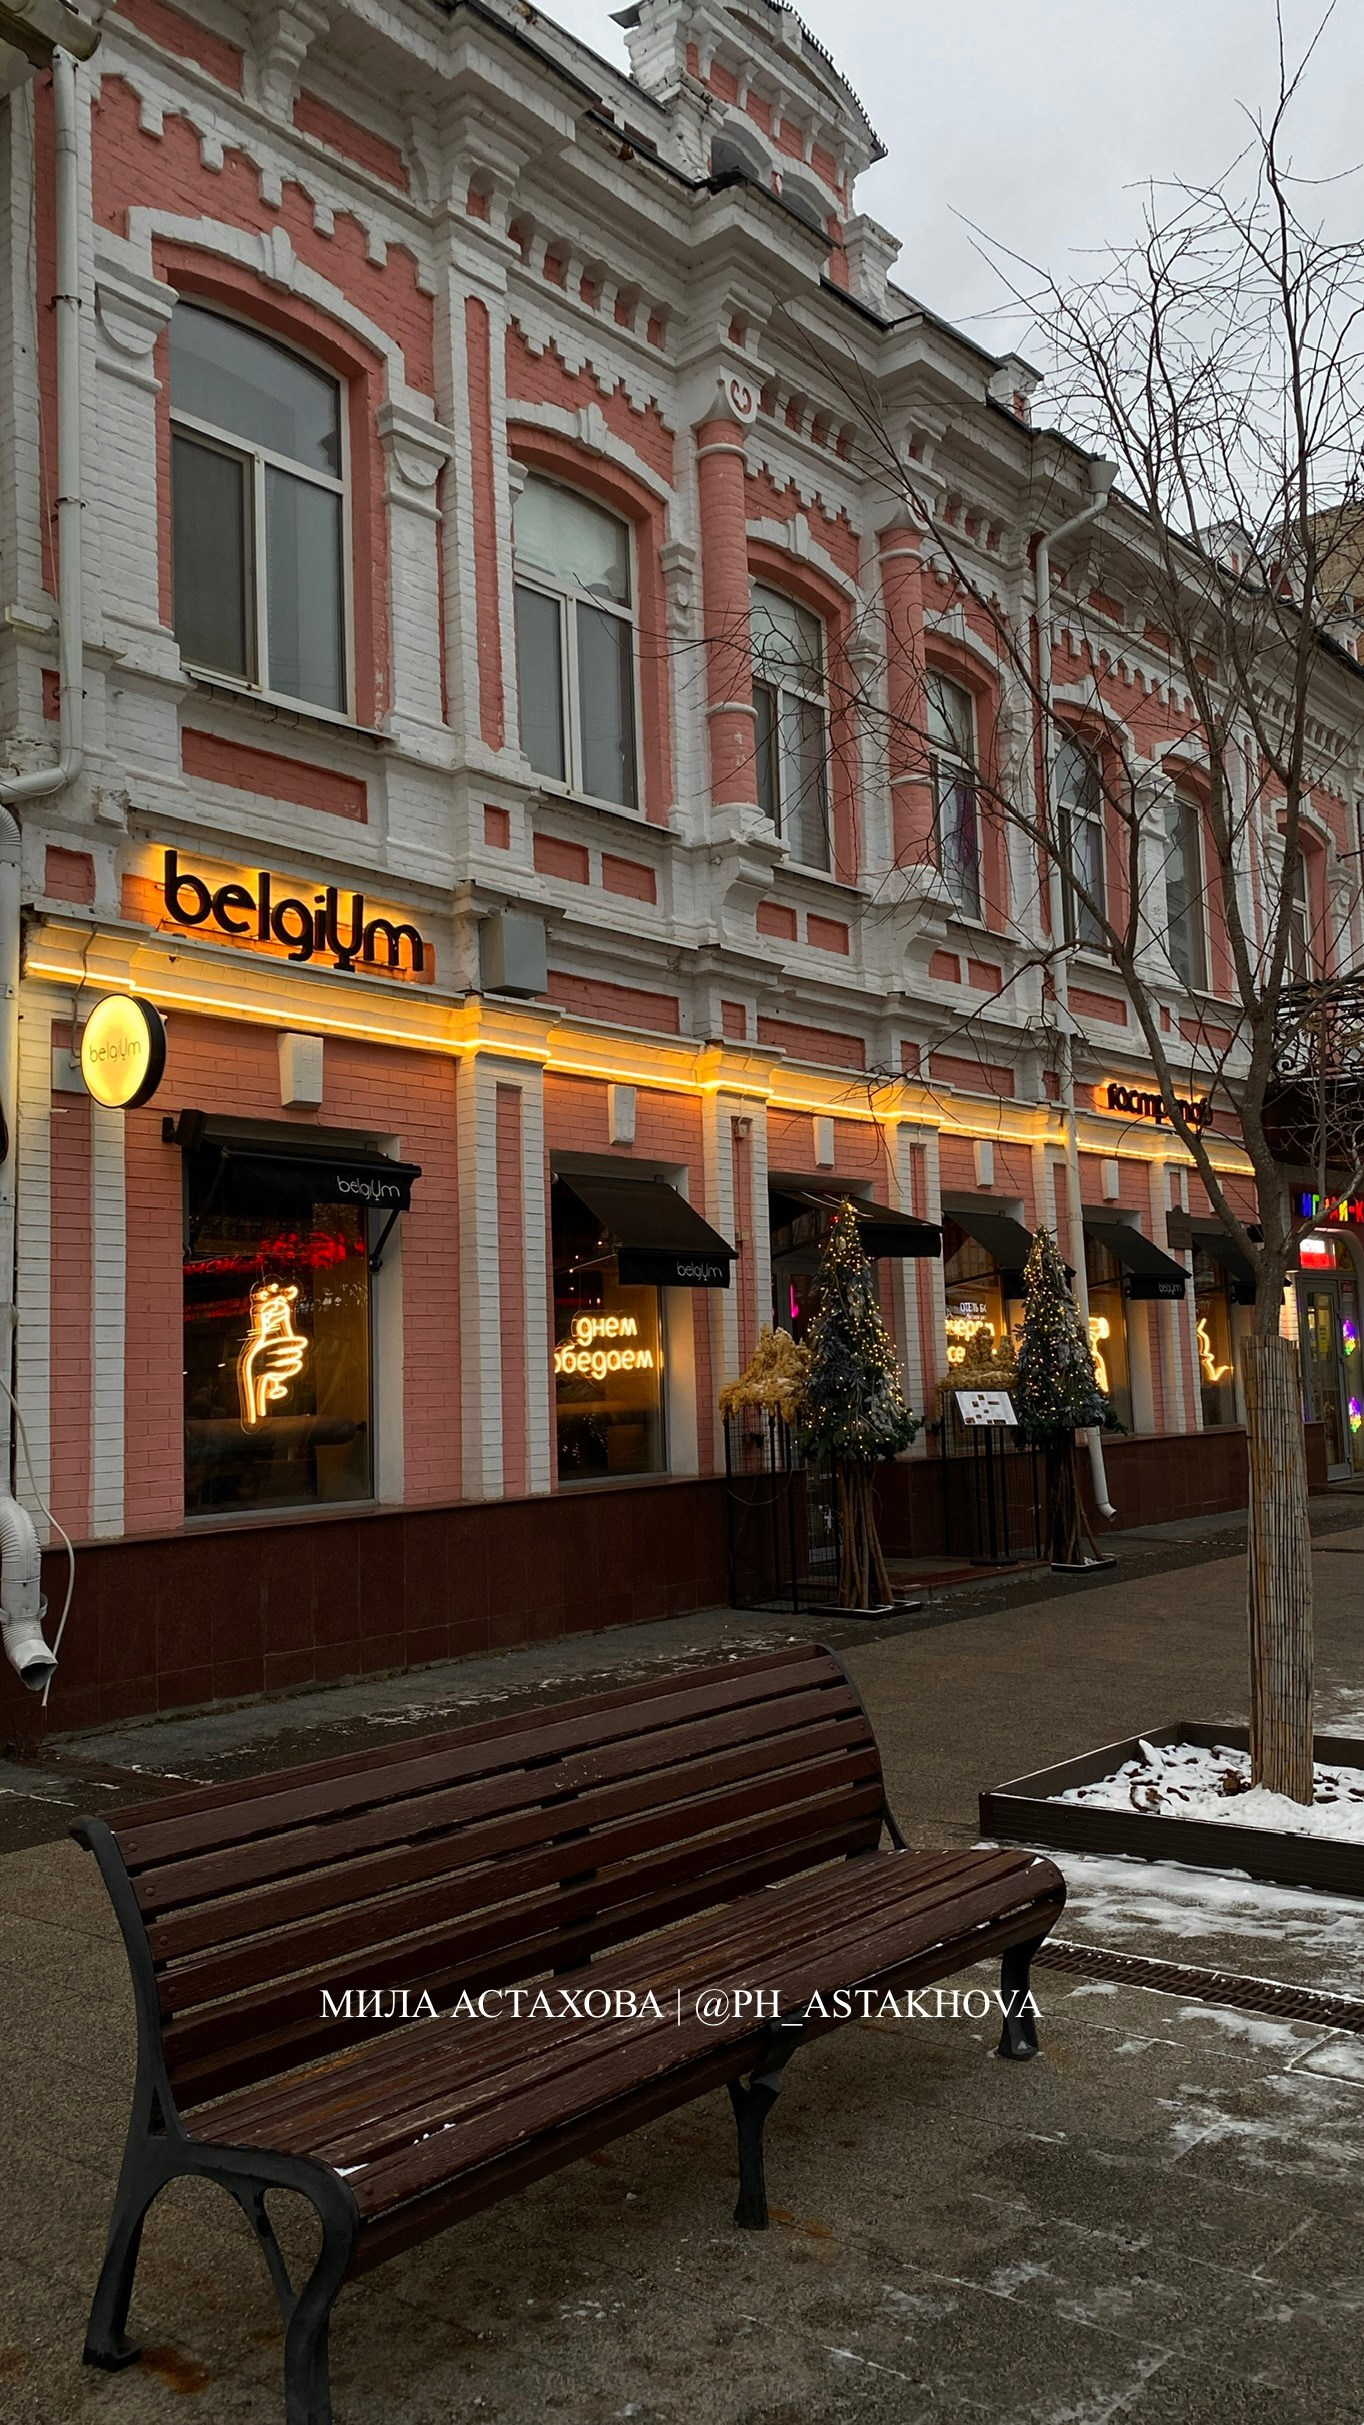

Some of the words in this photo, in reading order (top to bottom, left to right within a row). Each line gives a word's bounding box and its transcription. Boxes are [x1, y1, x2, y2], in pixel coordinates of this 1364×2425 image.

[164, 849, 424, 973] belgium
[1107, 1083, 1214, 1126] гастрпаб
[336, 1175, 401, 1201] belgium
[576, 1316, 638, 1347] днем
